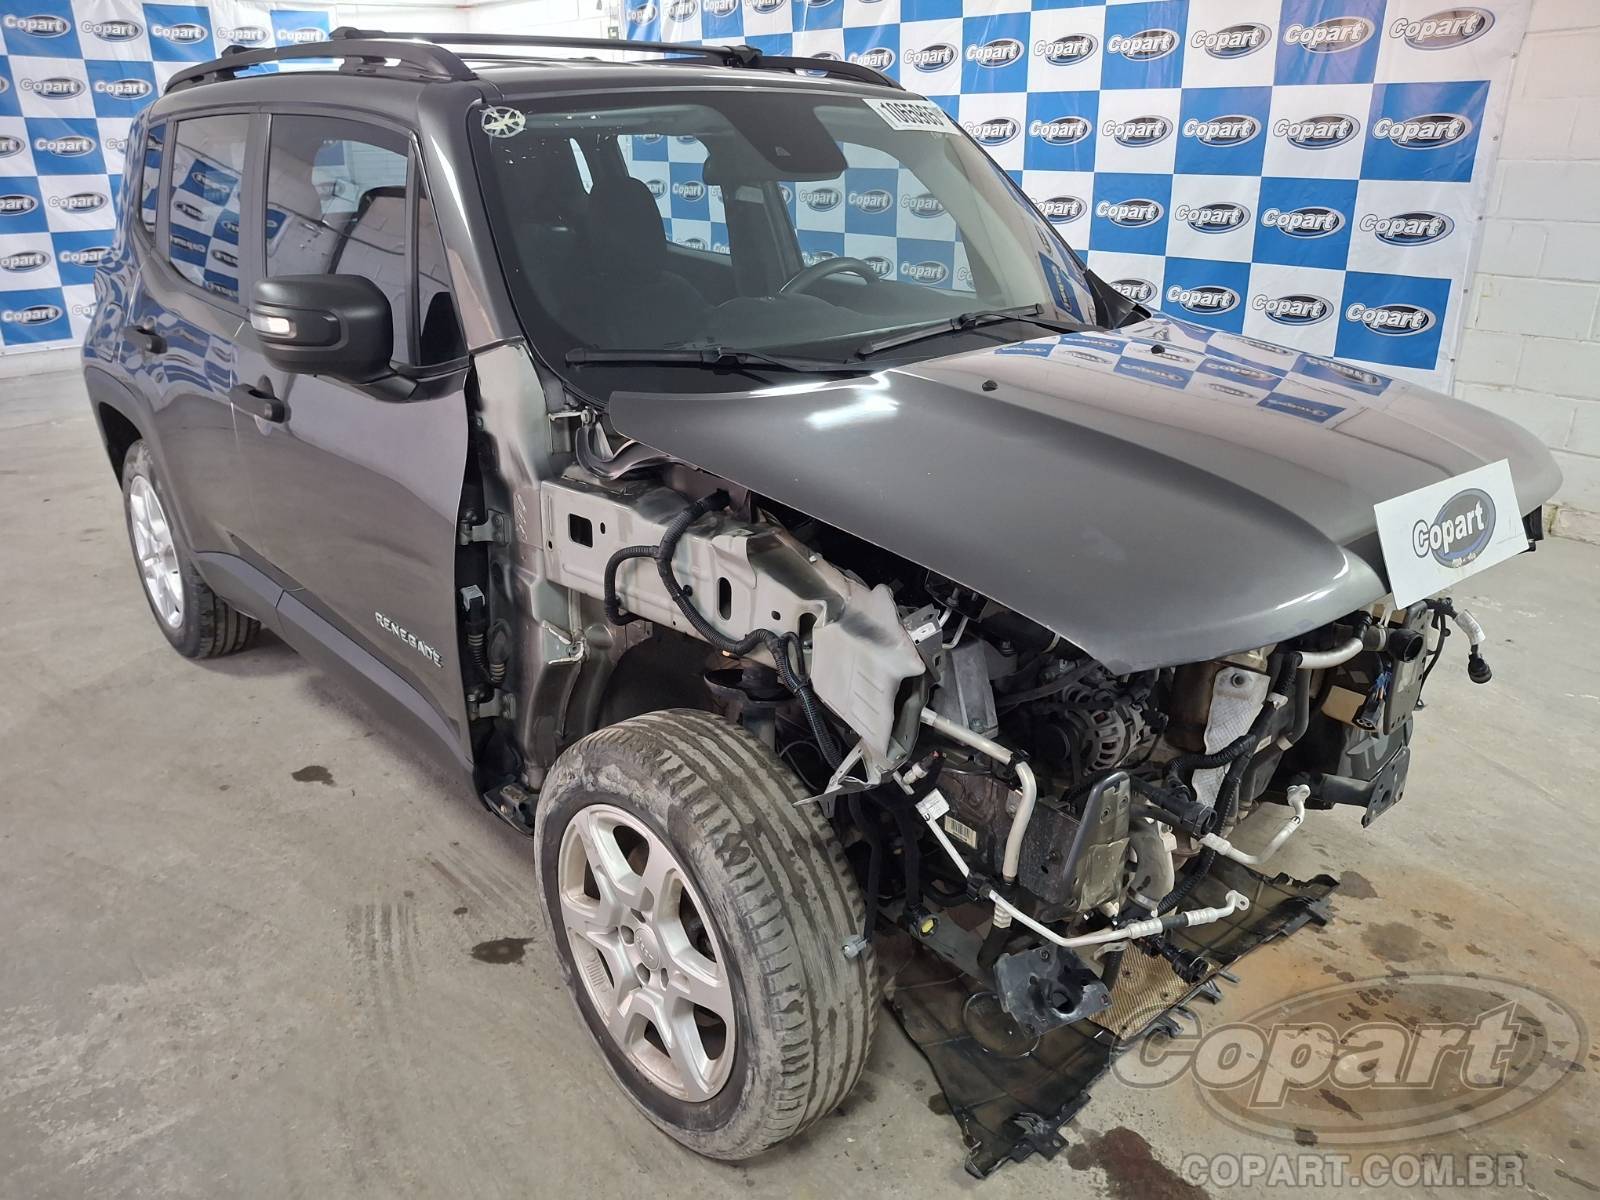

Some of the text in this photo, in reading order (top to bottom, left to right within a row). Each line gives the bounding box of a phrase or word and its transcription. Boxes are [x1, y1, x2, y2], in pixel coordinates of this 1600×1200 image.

[3, 15, 63, 33] Copart
[81, 21, 135, 36] Copart
[152, 23, 201, 39] Copart
[1389, 12, 1481, 42] Copart
[217, 27, 263, 42] Copart
[277, 29, 321, 43] Copart
[1108, 31, 1169, 56] Copart
[1191, 27, 1260, 51] Copart
[1283, 22, 1364, 48] Copart
[966, 40, 1017, 62] Copart
[1033, 36, 1090, 57] Copart
[903, 49, 951, 67] Copart
[20, 78, 75, 95] Copart
[95, 81, 146, 96] Copart
[962, 121, 1013, 137] Copart
[1029, 119, 1084, 138] Copart
[1102, 118, 1165, 141] Copart
[1183, 115, 1253, 142] Copart
[1272, 117, 1351, 143] Copart
[1373, 117, 1462, 144] Copart
[35, 138, 90, 154] Copart
[672, 184, 701, 198] Copart
[799, 190, 836, 206] Copart
[48, 195, 99, 210] Copart
[848, 193, 889, 210] Copart
[1032, 199, 1078, 217] opart
[1097, 200, 1156, 224] Copart
[1175, 203, 1243, 229] Copart
[1261, 208, 1335, 234] Copart
[1359, 213, 1445, 240] Copart
[0, 254, 41, 270] opart
[901, 262, 943, 279] Copart
[1166, 285, 1234, 308] Copart
[2, 309, 56, 324] Copart
[1252, 294, 1326, 320] Copart
[1346, 303, 1430, 331] Copart
[1413, 500, 1485, 558] Copart
[375, 611, 442, 668] RENEGADE
